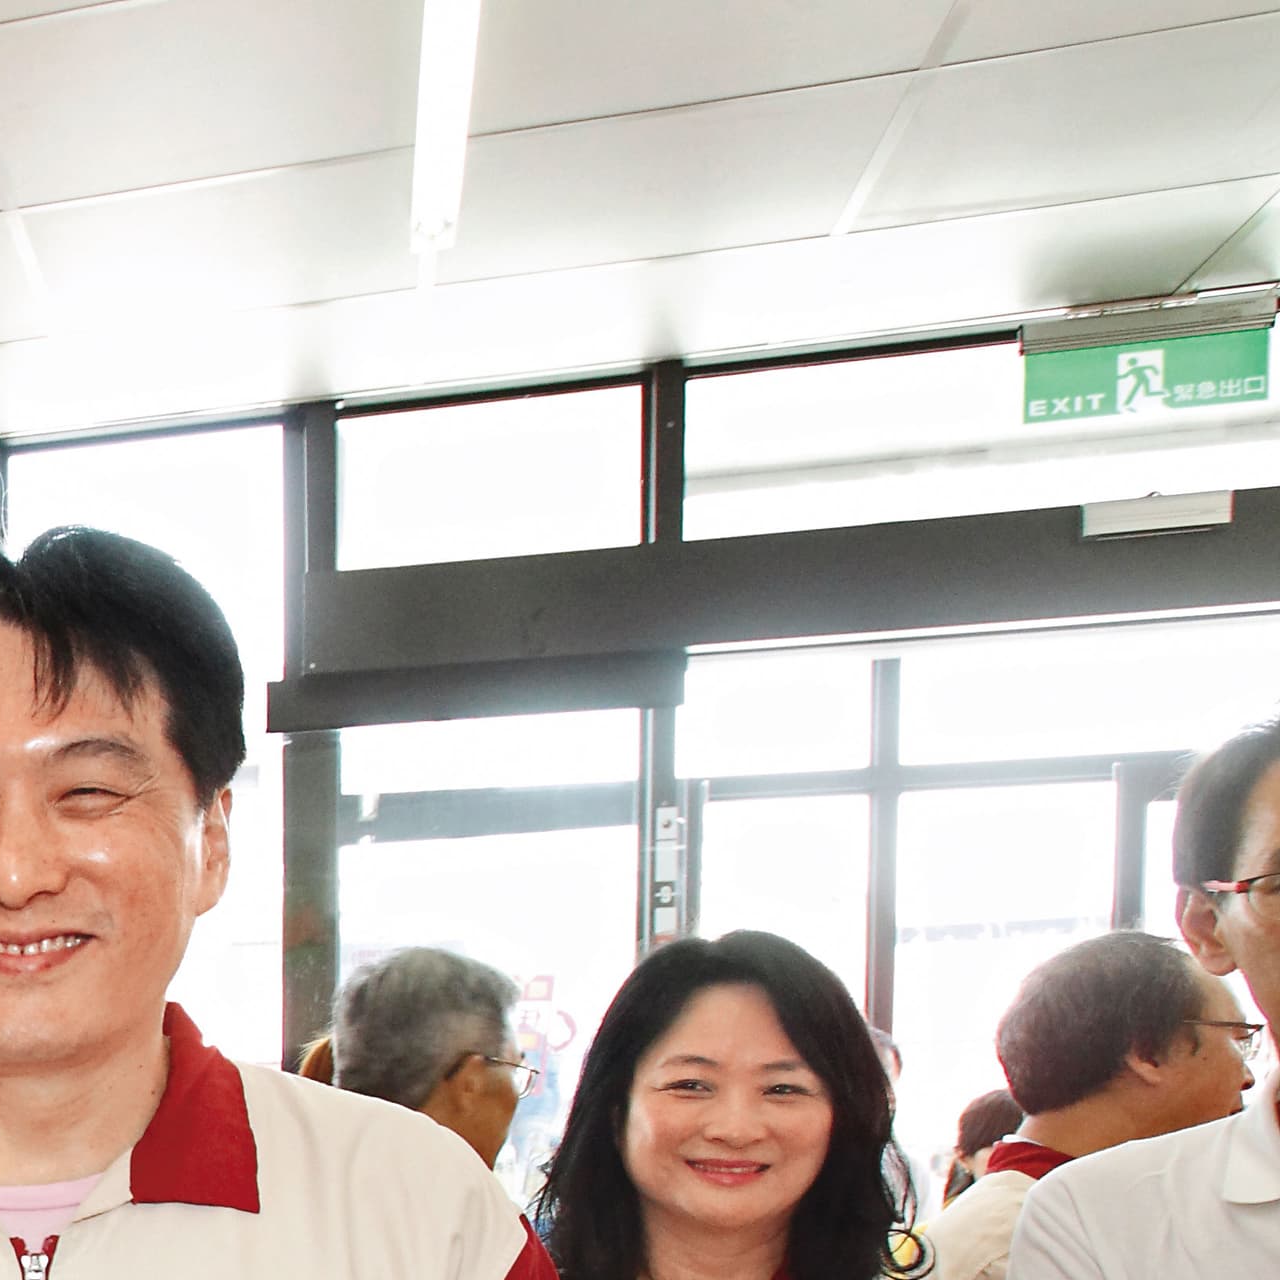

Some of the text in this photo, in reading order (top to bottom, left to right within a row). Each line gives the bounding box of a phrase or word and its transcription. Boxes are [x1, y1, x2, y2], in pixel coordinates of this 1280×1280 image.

[1173, 375, 1266, 402] 緊急出口
[1028, 393, 1107, 417] EXIT
